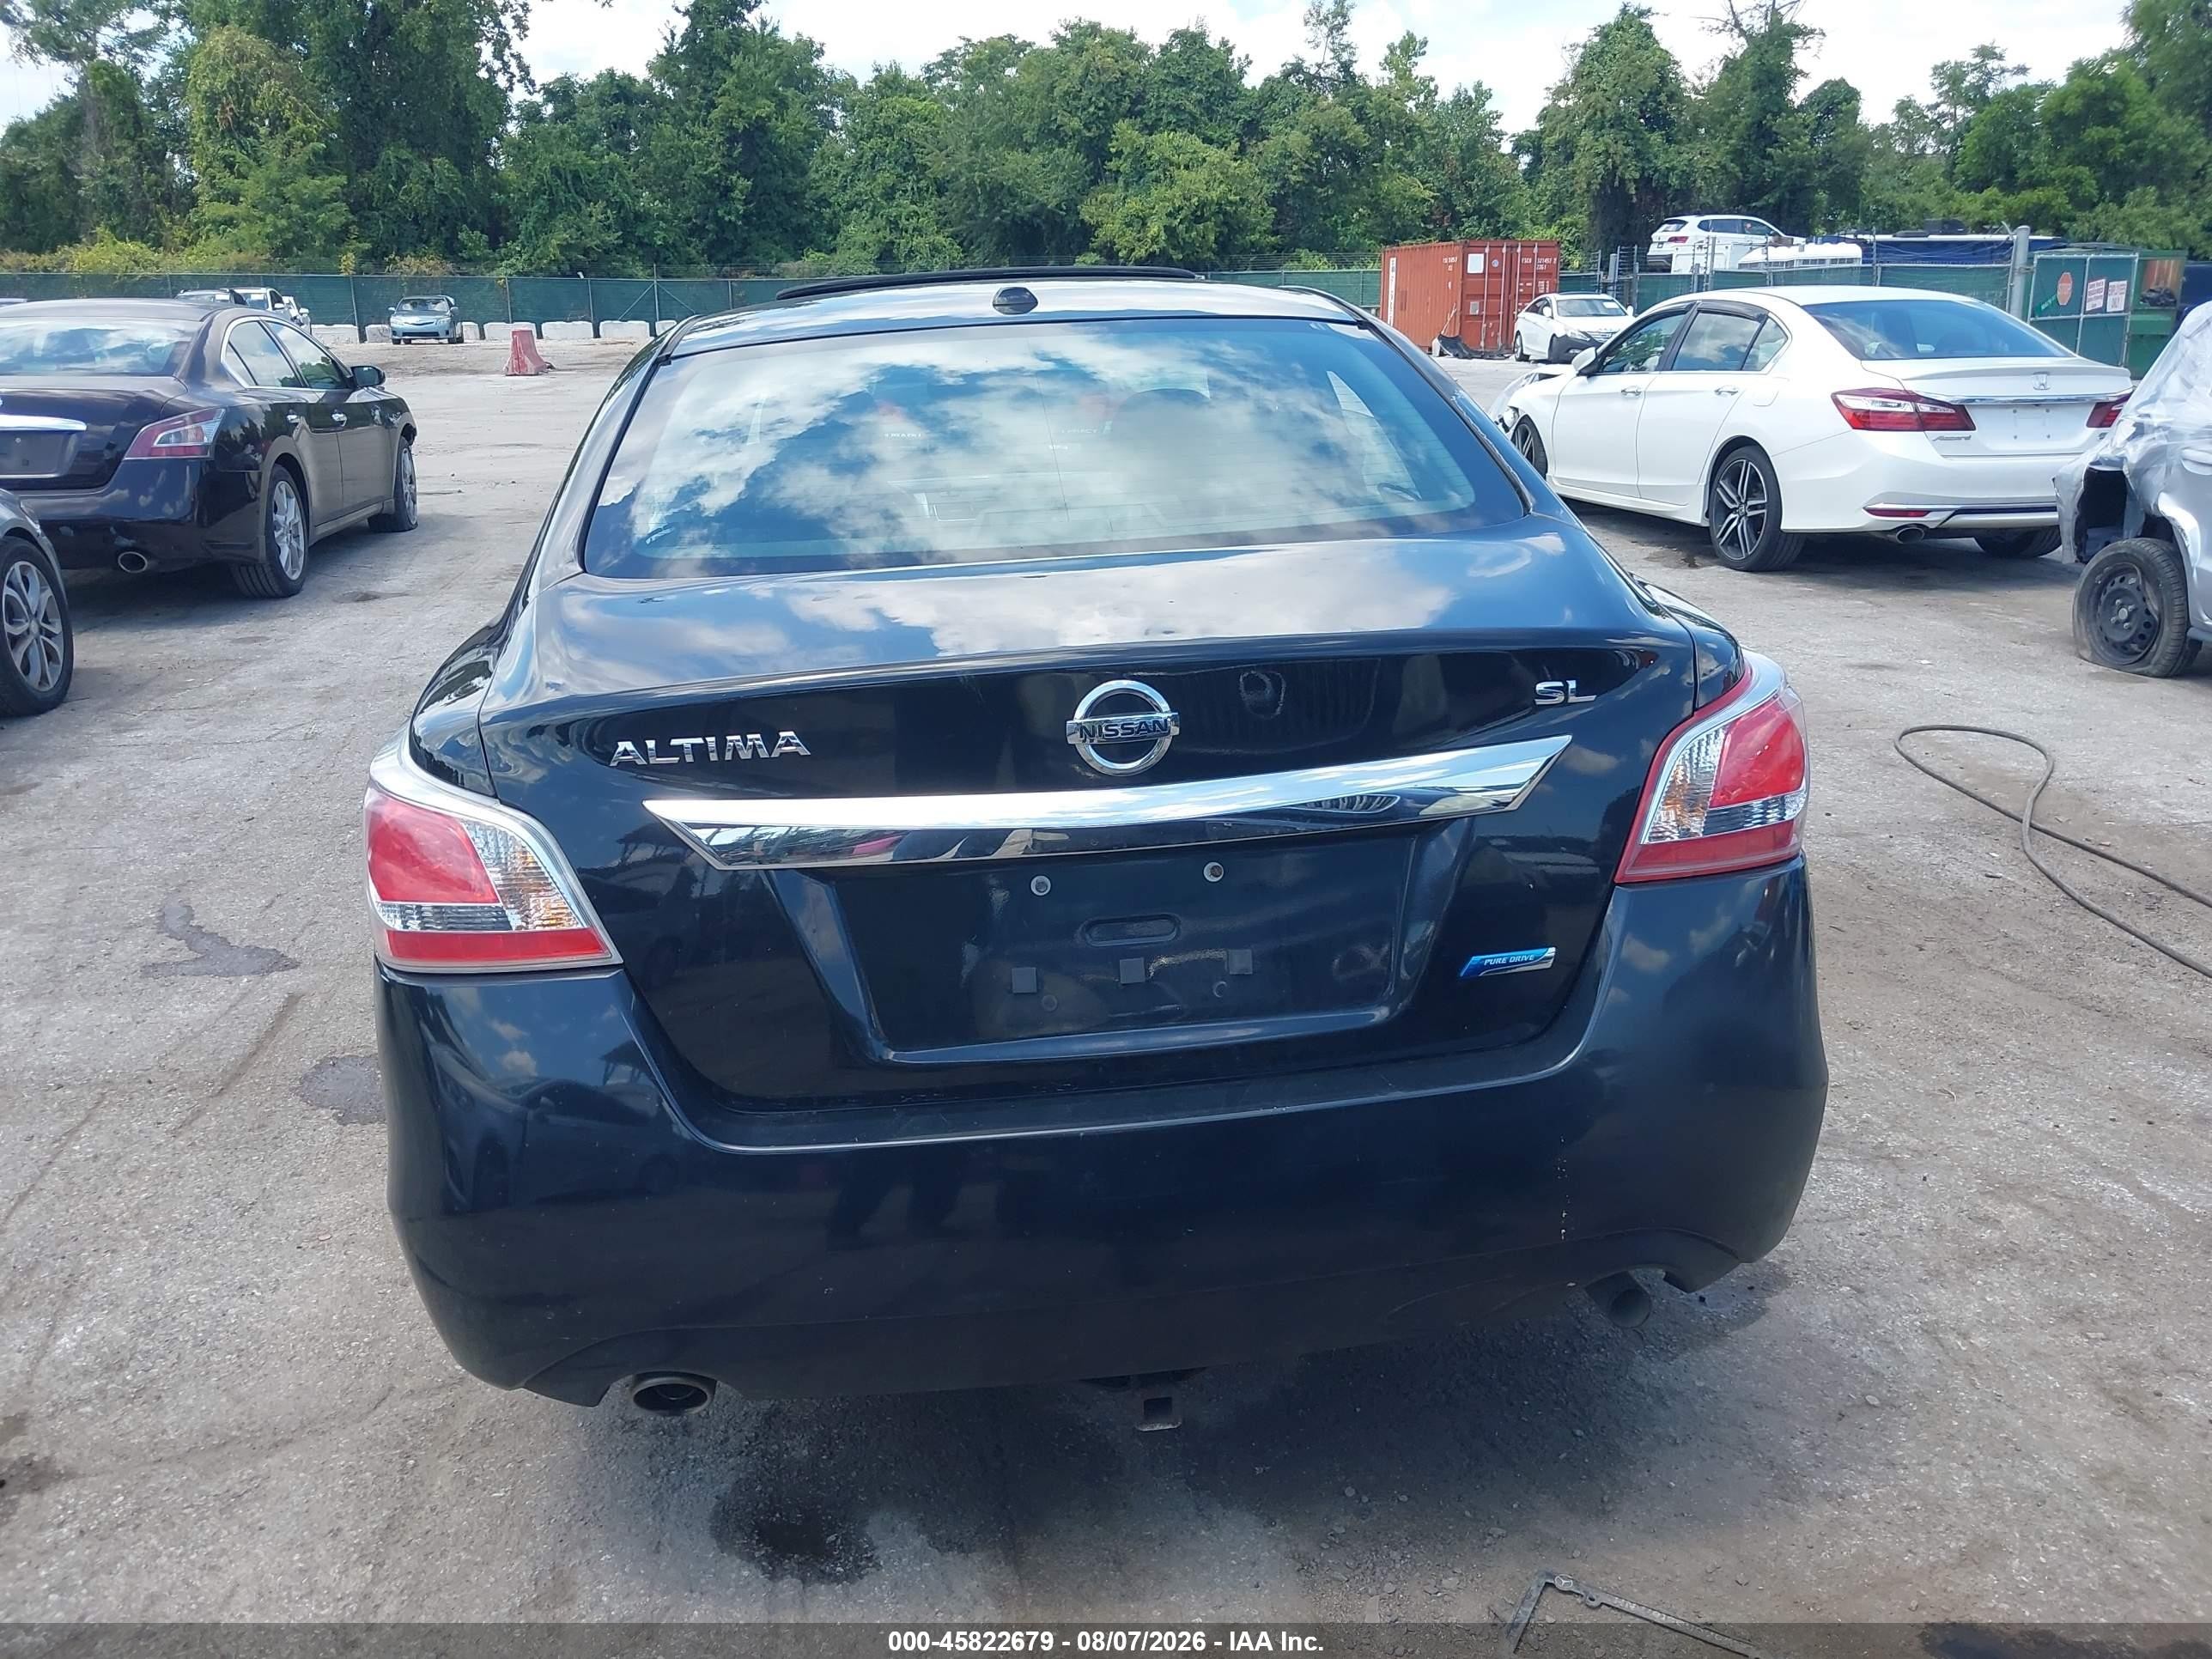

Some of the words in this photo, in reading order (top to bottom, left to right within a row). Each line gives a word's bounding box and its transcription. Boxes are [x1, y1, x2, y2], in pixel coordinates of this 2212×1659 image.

[1534, 680, 1597, 705] SL
[1079, 719, 1168, 739] NISSAN
[609, 731, 811, 767] ALTIMA
[1483, 957, 1506, 966] PURE
[1509, 954, 1535, 963] DRIVE
